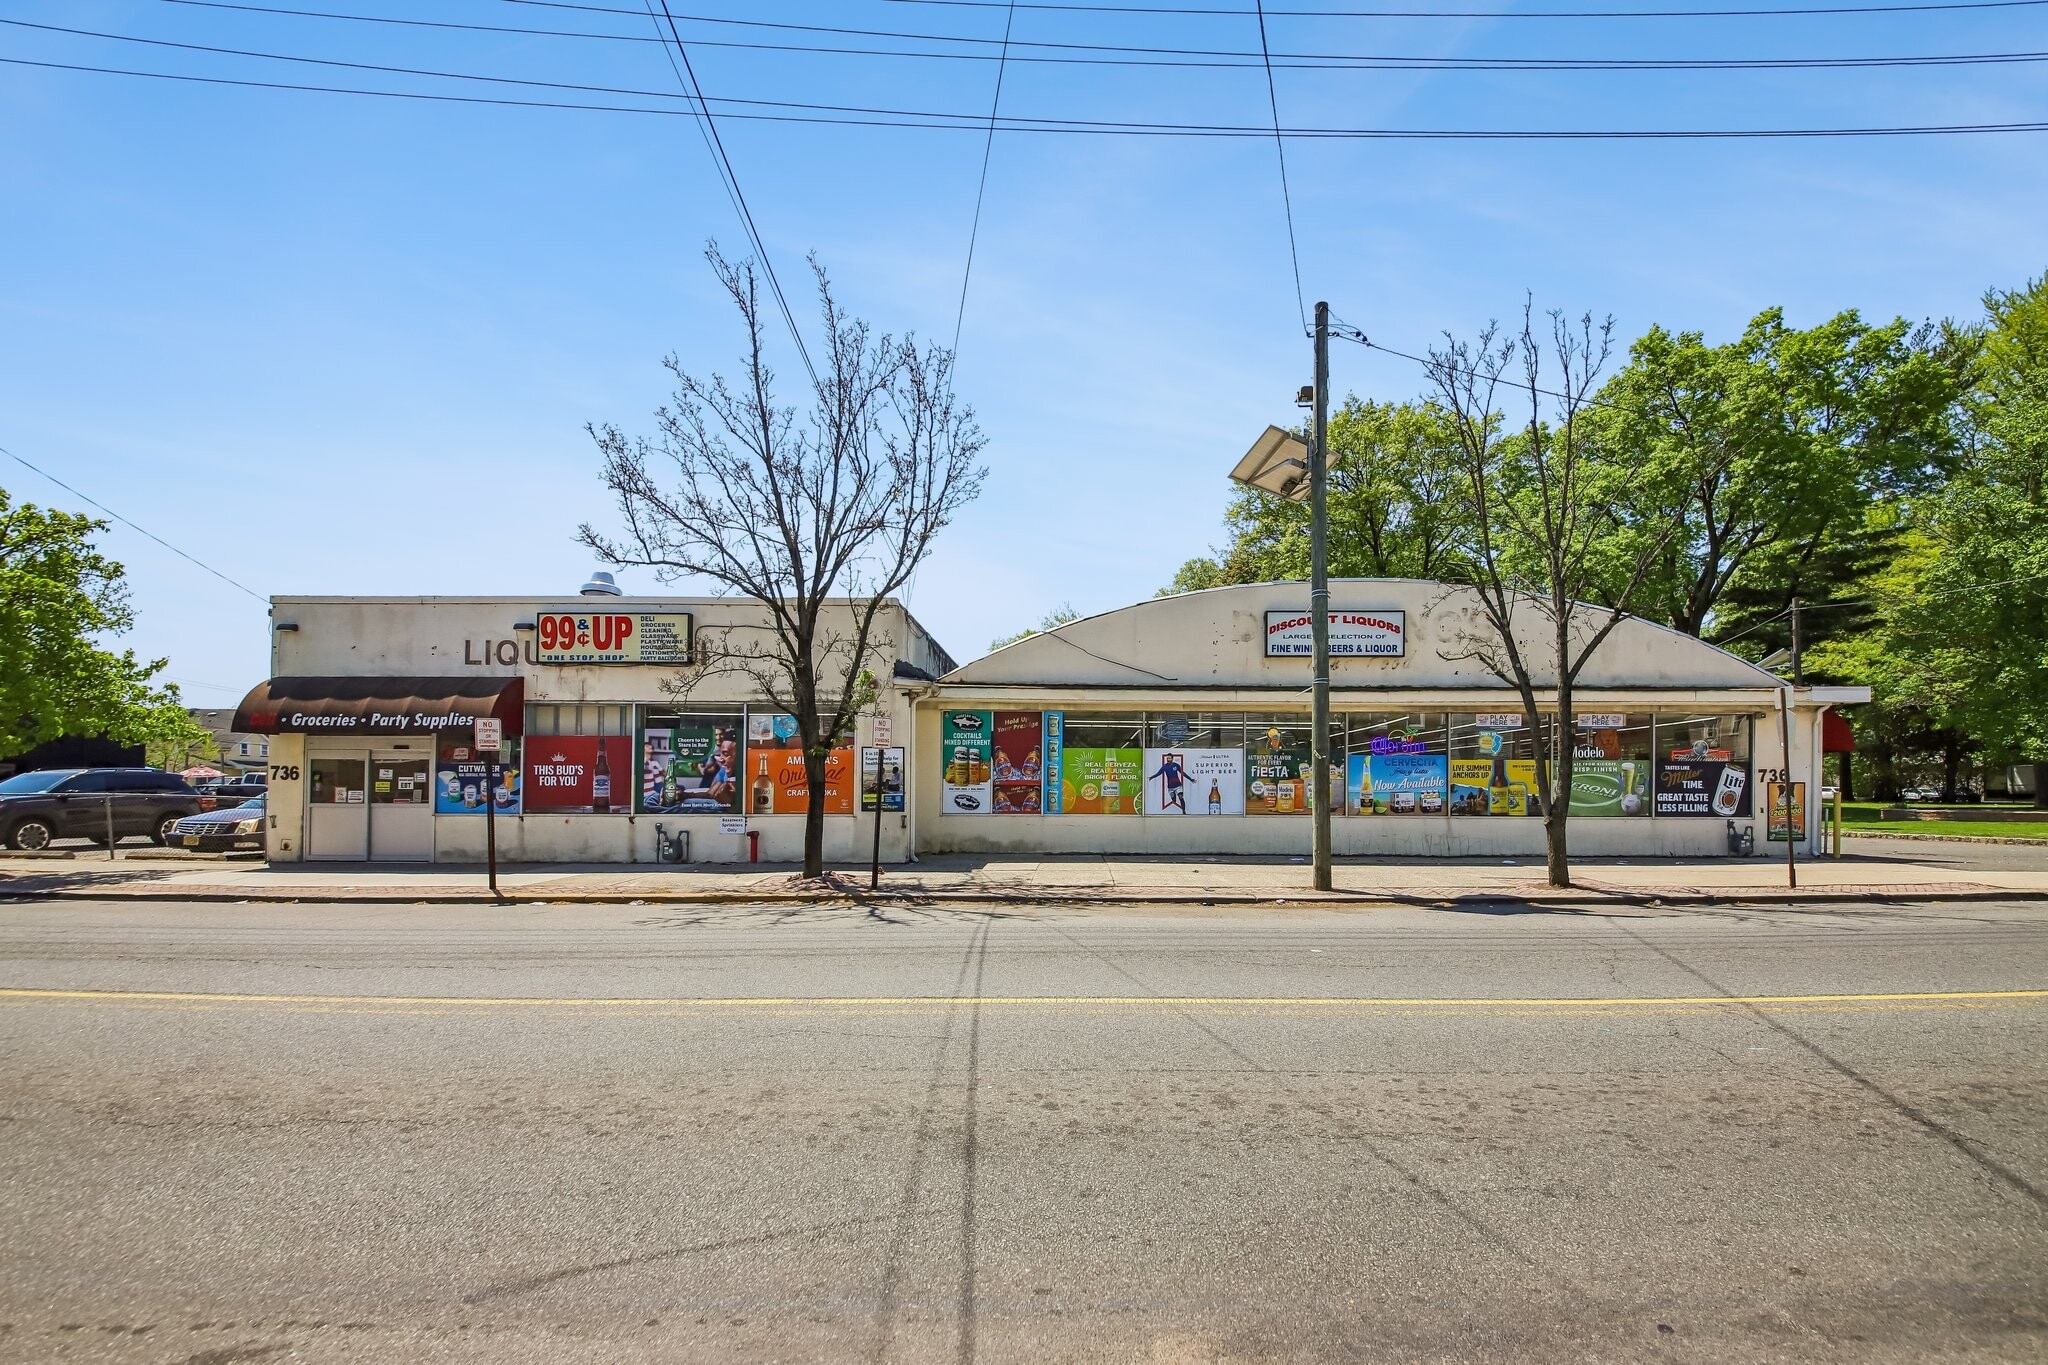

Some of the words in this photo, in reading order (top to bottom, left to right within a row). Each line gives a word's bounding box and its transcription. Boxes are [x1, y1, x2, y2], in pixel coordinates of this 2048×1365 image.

[1270, 616, 1338, 634] DISCOUT
[1343, 616, 1400, 634] LIQUORS
[592, 616, 633, 650] UP
[1356, 645, 1362, 653] &
[1366, 645, 1397, 653] LIQUOR
[292, 713, 357, 726] Groceries
[371, 713, 410, 729] Party
[414, 712, 474, 729] Supplies
[1384, 758, 1438, 766] CERVECITA
[270, 766, 300, 780] 736
[534, 765, 554, 775] THIS
[556, 765, 584, 775] BUD'S
[1758, 769, 1787, 782] 736
[540, 776, 557, 786] FOR
[559, 776, 577, 786] YOU
[1374, 780, 1396, 791] Now
[1398, 776, 1444, 789] Available
[1661, 769, 1703, 787] Miller
[1723, 774, 1744, 789] Lite
[1657, 793, 1683, 801] GREAT
[1684, 793, 1709, 801] TASTE
[1658, 804, 1676, 812] LESS
[1678, 804, 1708, 812] FILLING
